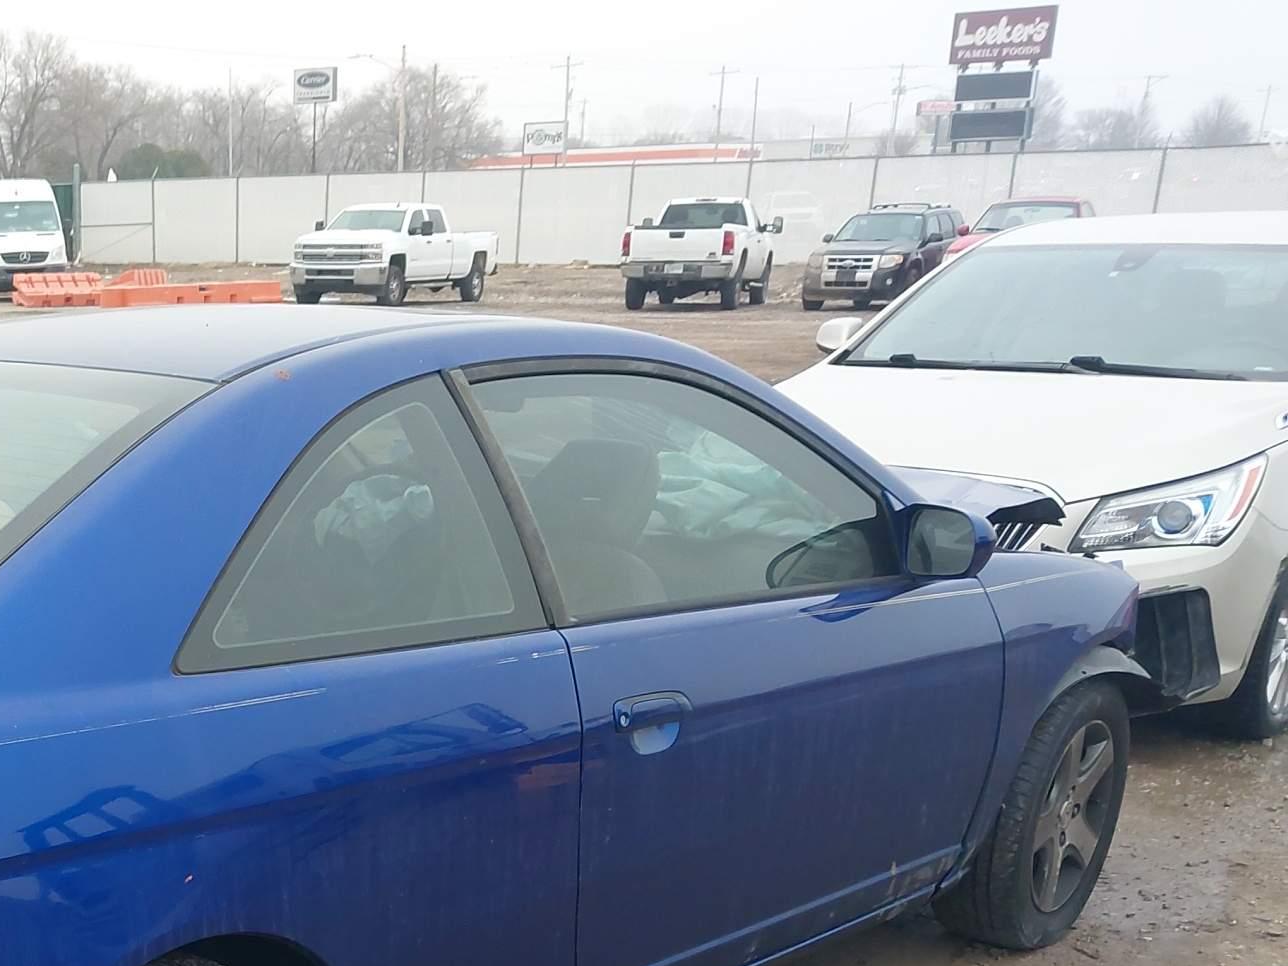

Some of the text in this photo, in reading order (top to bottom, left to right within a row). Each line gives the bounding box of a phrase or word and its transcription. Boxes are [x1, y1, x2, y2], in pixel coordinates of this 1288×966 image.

[954, 15, 1050, 48] Leeker's
[957, 44, 1042, 60] FAMILY FOODS
